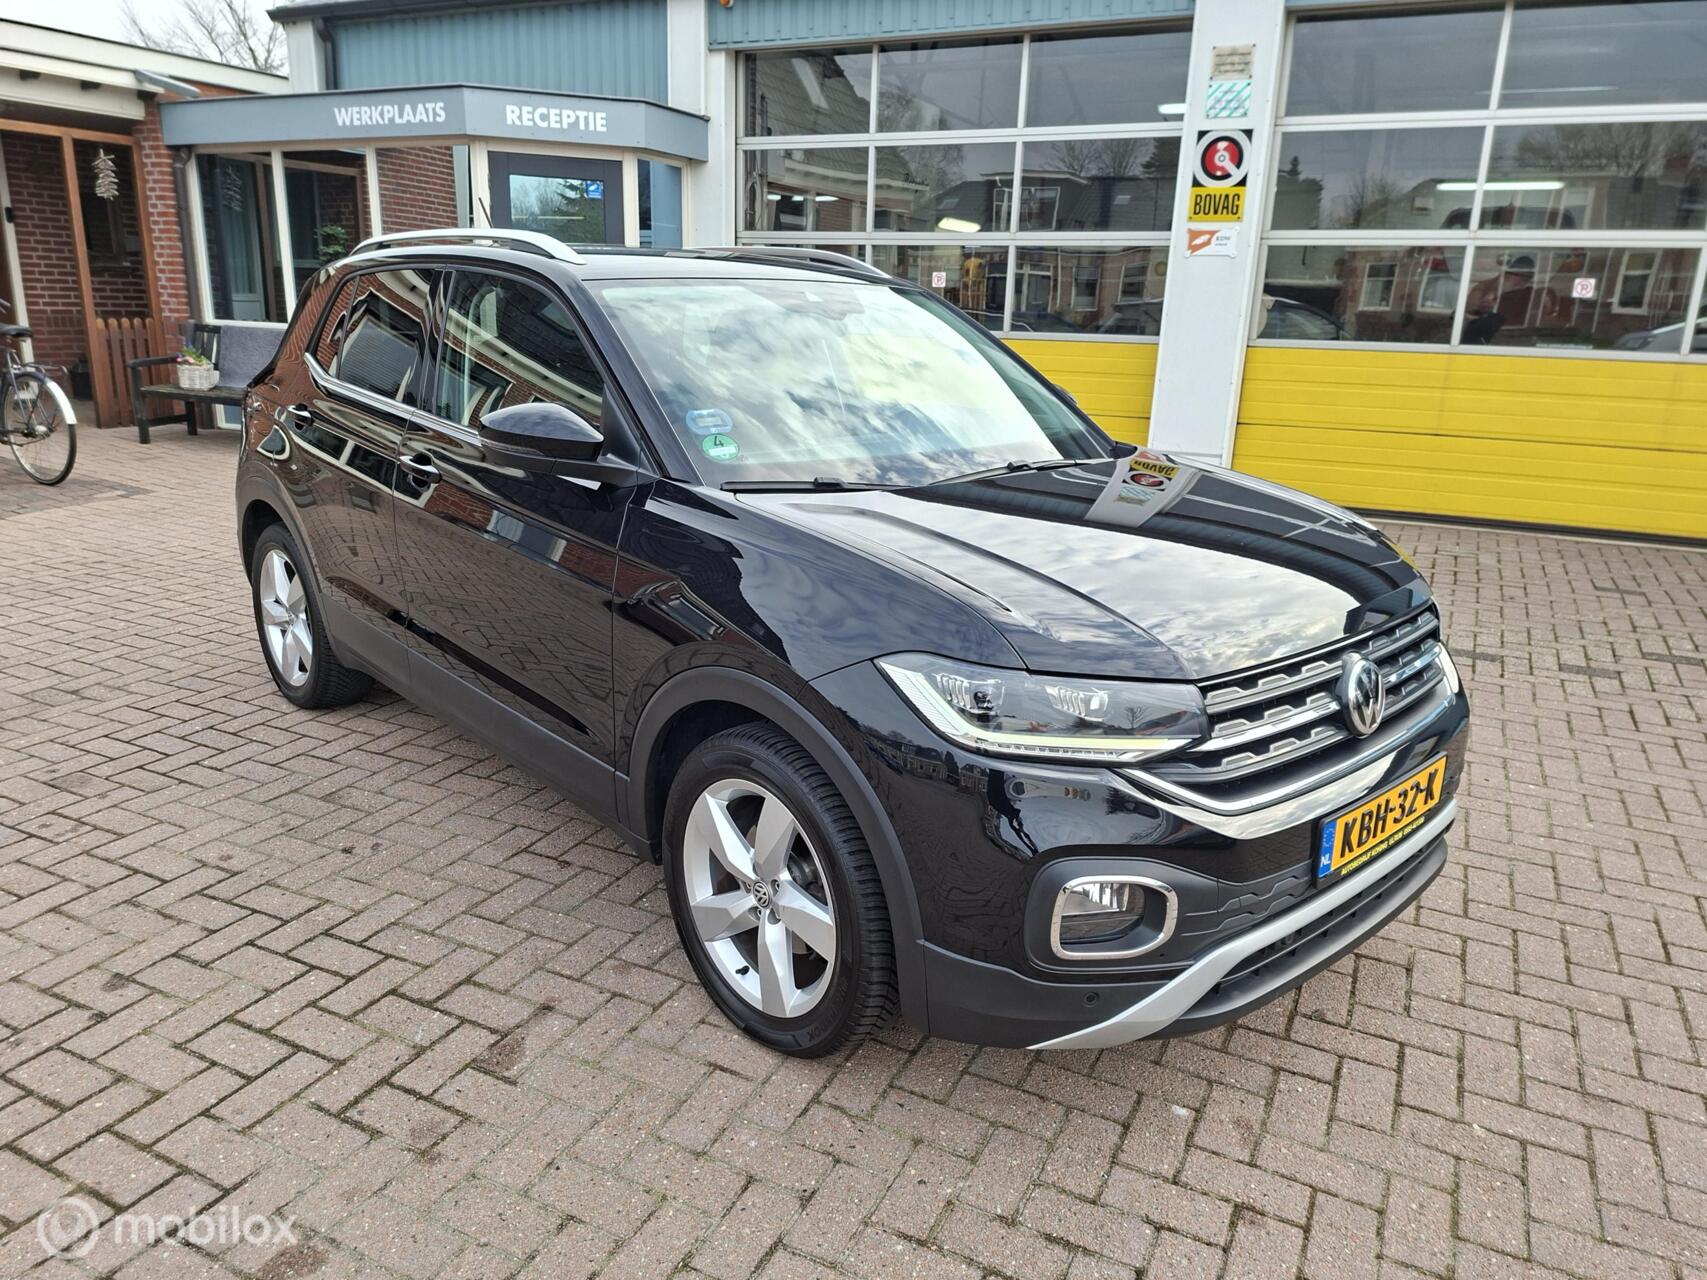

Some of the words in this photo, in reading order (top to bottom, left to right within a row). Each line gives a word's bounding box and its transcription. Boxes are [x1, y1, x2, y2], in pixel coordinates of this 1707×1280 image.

[334, 102, 446, 126] WERKPLAATS
[505, 104, 607, 132] RECEPTIE
[1193, 193, 1240, 216] BOVAG
[714, 435, 724, 447] 4
[1339, 768, 1440, 858] KBH-32-K
[1320, 853, 1331, 867] NL
